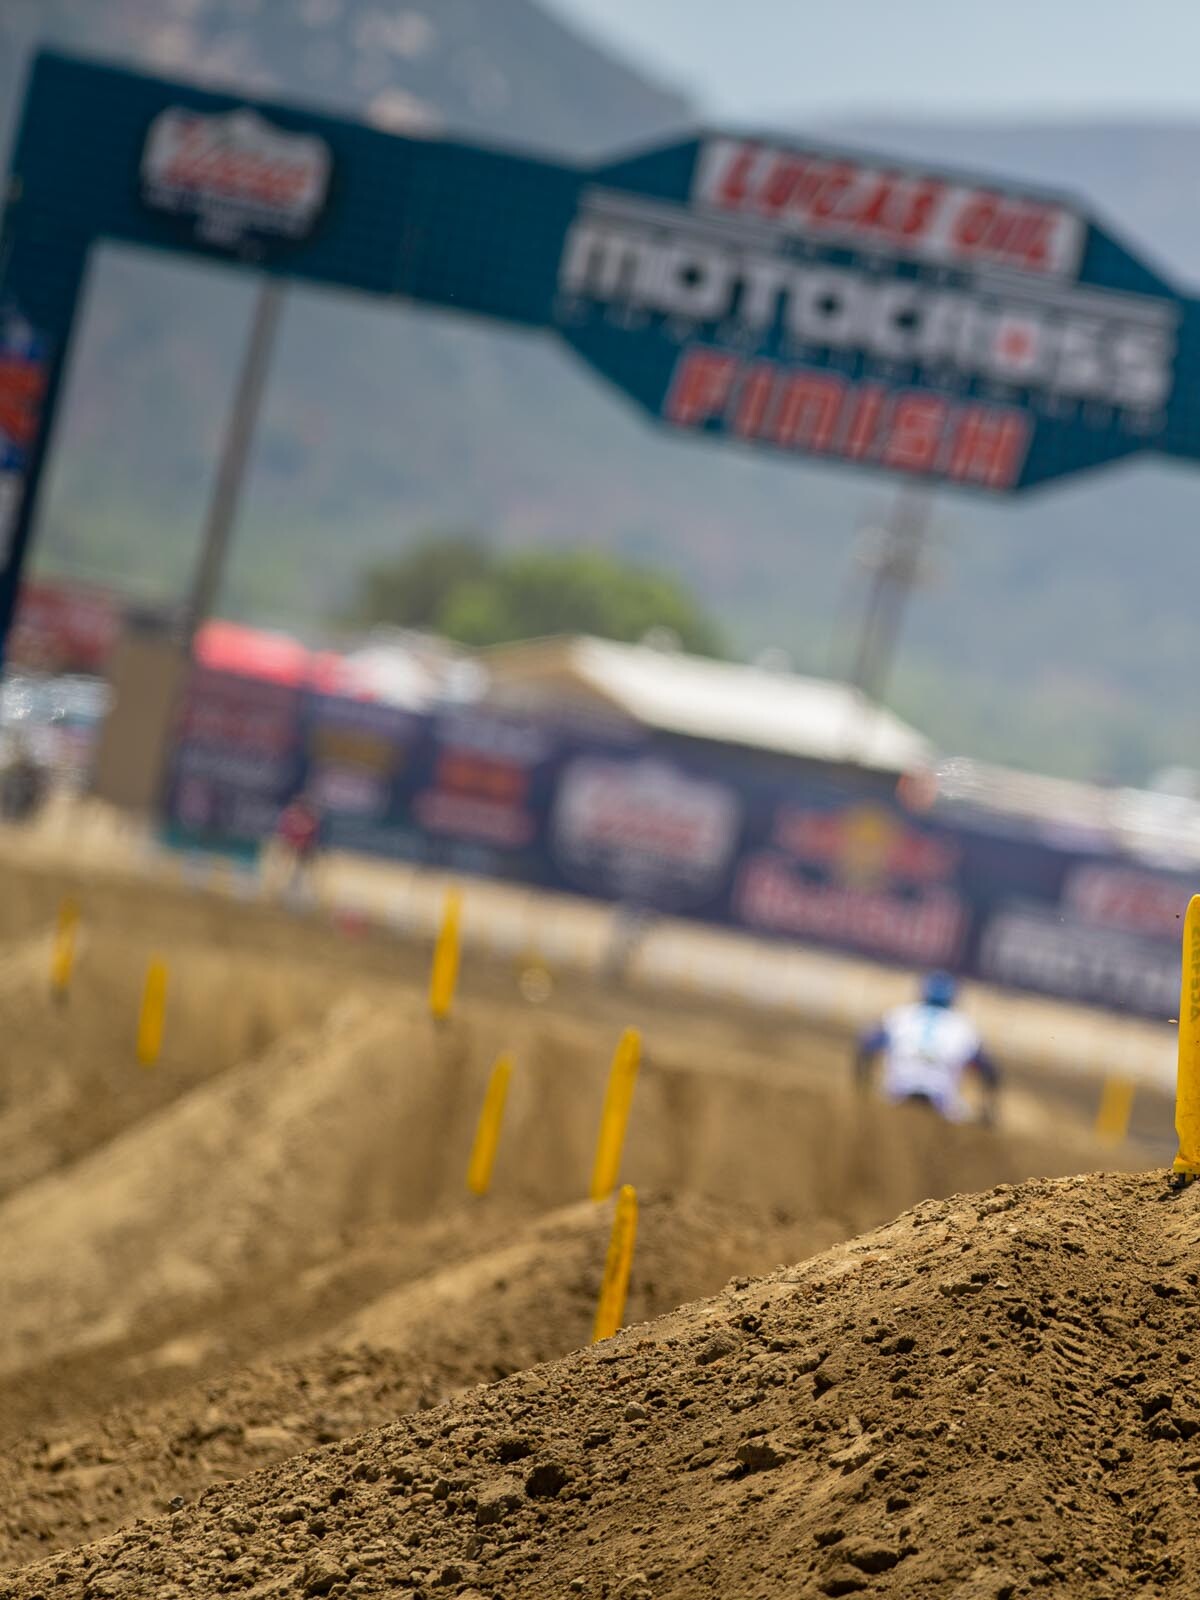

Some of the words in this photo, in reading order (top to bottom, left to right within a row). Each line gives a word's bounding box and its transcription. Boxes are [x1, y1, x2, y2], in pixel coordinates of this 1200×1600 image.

[714, 137, 943, 249] LUCAS
[950, 188, 1064, 277] OIL
[558, 217, 1176, 411] MOTOCROSS
[665, 344, 1034, 490] FINISH
